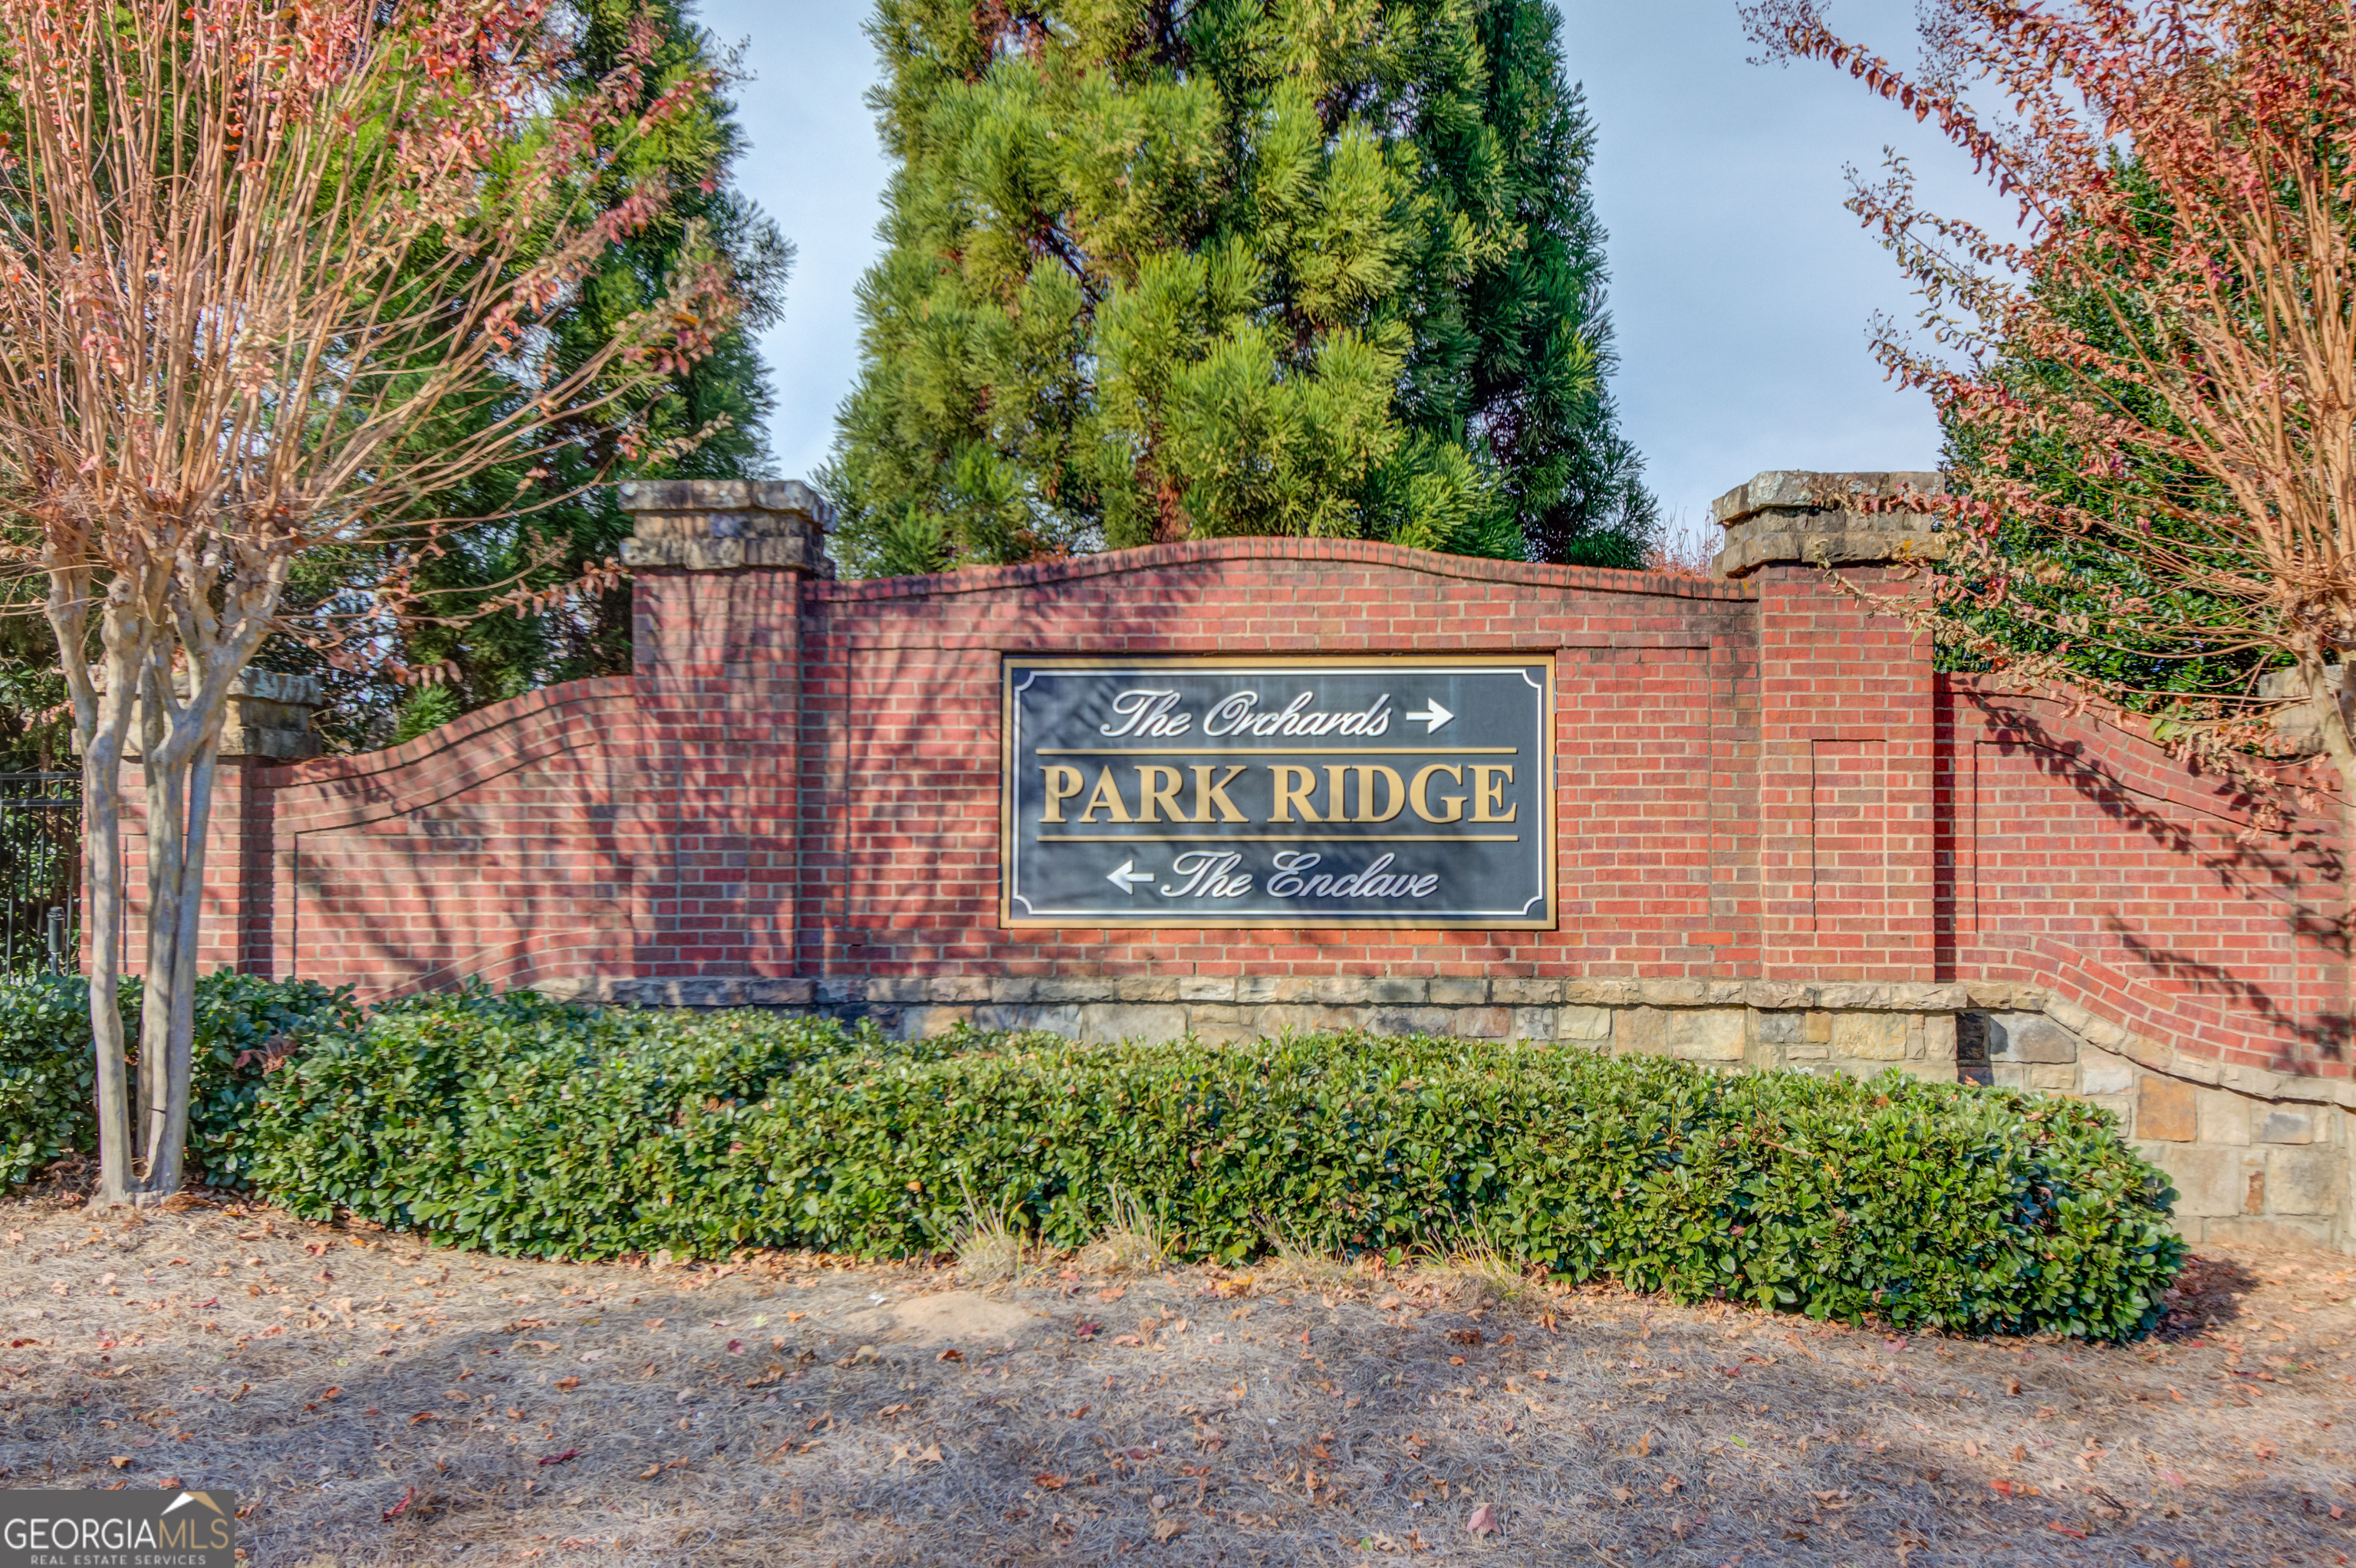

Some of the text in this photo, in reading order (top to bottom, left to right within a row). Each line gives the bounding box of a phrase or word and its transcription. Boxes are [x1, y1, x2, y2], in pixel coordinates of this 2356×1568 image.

[1100, 689, 1393, 737] The Orchards
[1038, 763, 1519, 823] PARK RIDGE
[1160, 850, 1440, 899] The Enclave
